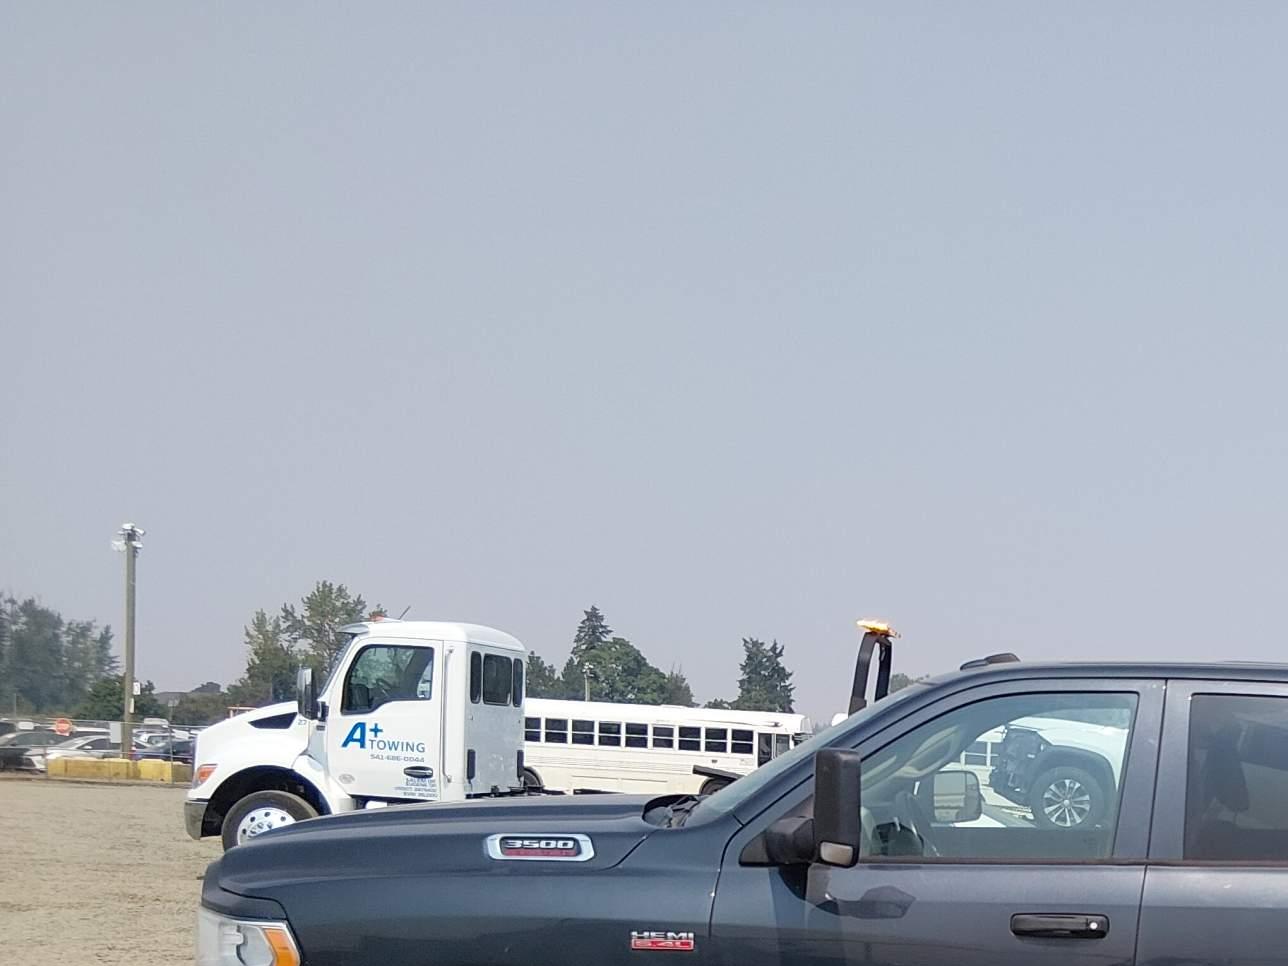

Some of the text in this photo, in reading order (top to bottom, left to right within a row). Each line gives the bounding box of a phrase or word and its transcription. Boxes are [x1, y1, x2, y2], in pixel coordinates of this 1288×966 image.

[369, 739, 426, 753] TOWING
[504, 839, 575, 850] 3500
[631, 931, 694, 940] HEMI
